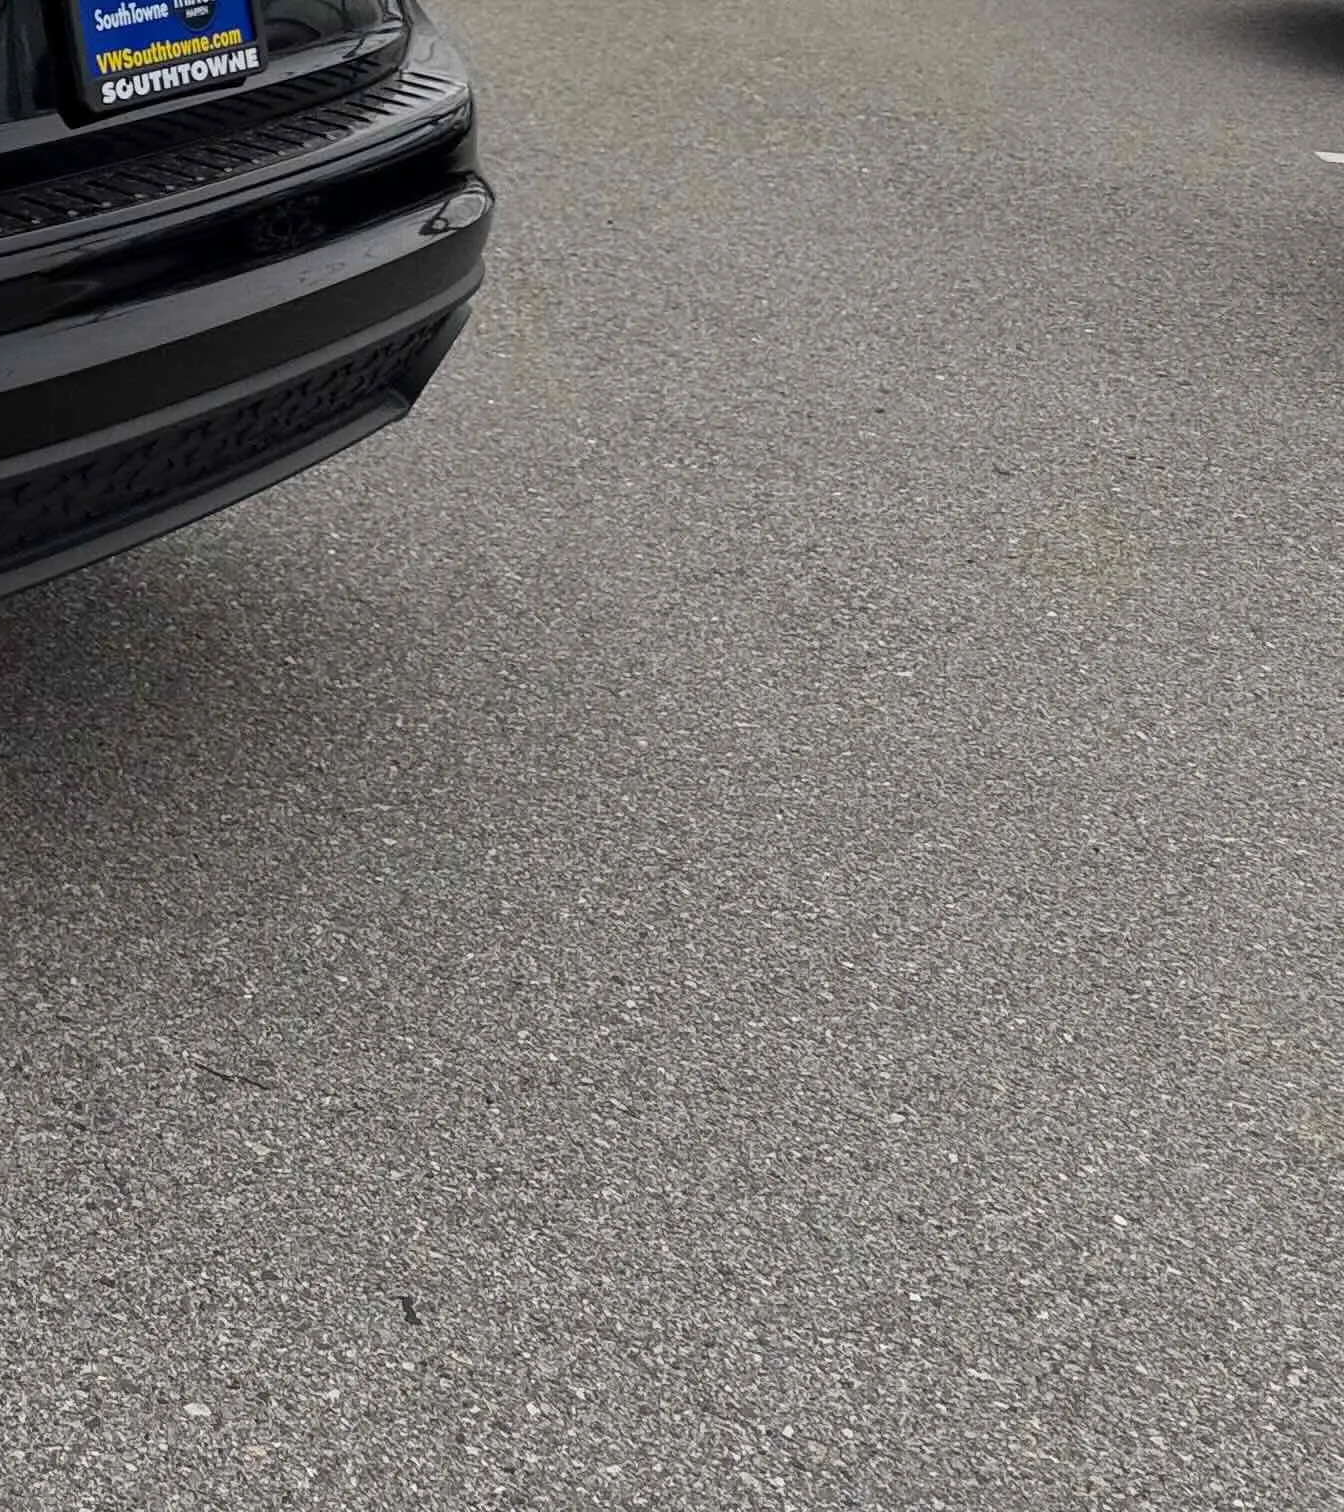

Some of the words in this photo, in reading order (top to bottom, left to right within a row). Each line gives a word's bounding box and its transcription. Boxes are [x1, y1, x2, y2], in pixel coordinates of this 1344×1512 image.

[94, 2, 169, 32] SouthTowne
[96, 29, 242, 75] VWSouthtowne.com
[101, 47, 260, 104] SOUTHTOWNE
